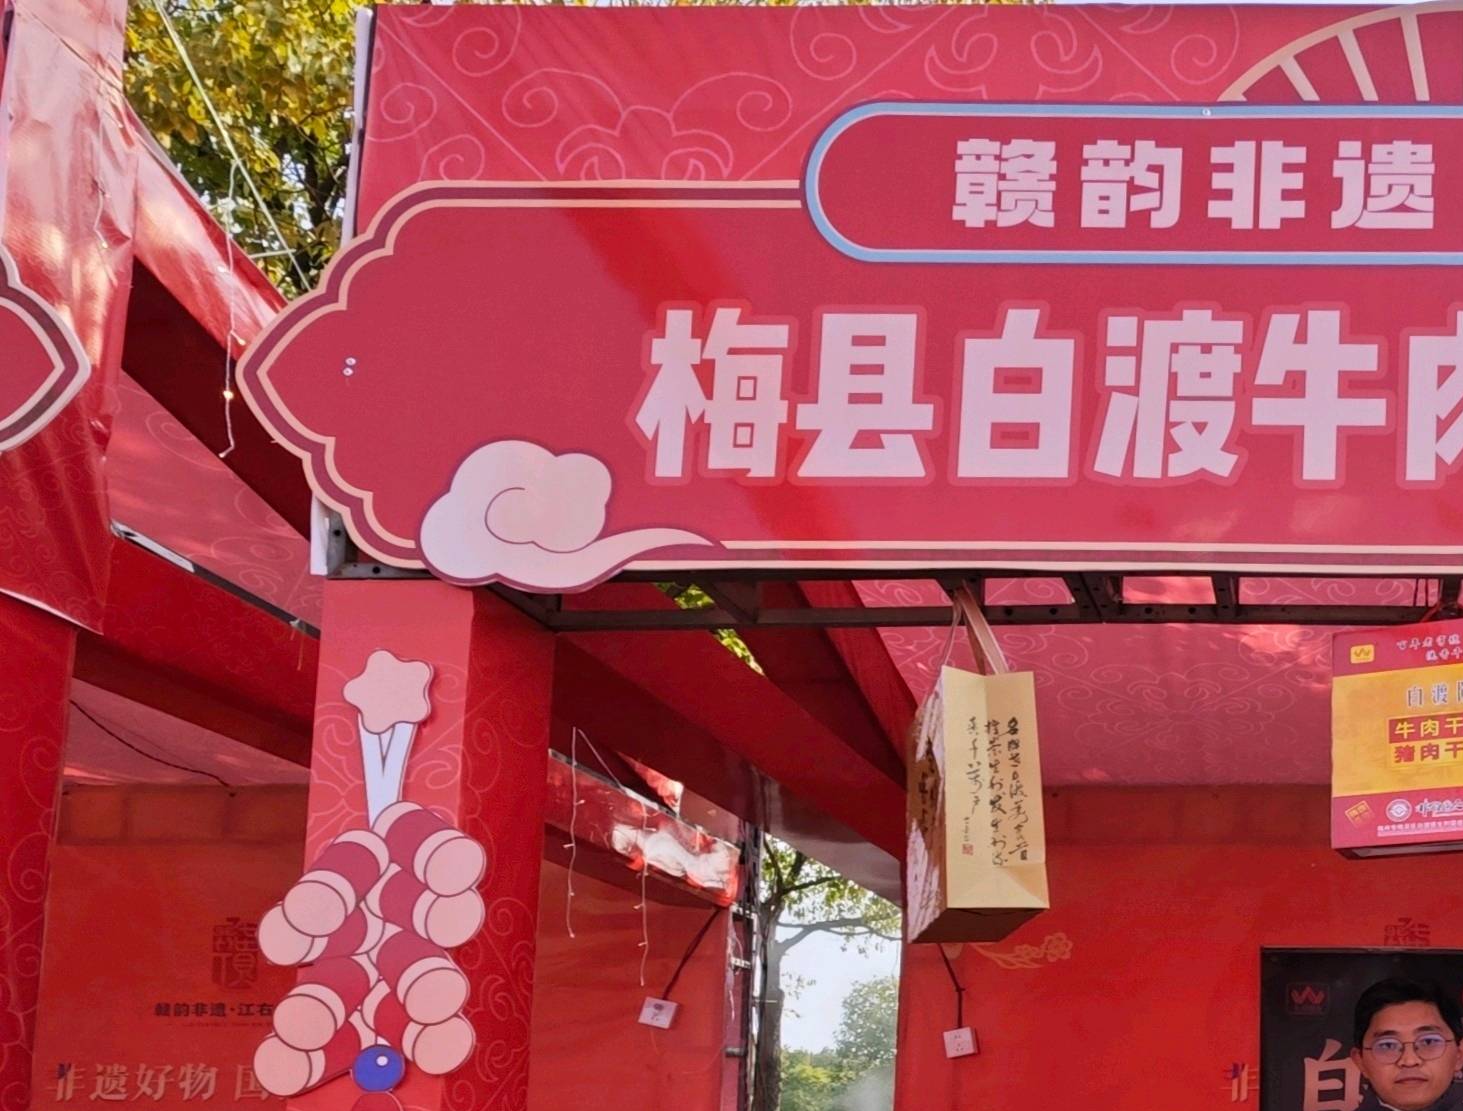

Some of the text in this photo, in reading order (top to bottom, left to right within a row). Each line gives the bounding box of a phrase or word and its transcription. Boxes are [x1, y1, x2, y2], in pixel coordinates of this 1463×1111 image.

[952, 138, 1436, 230] 赣韵非遗
[44, 1063, 218, 1100] 非遗好物
